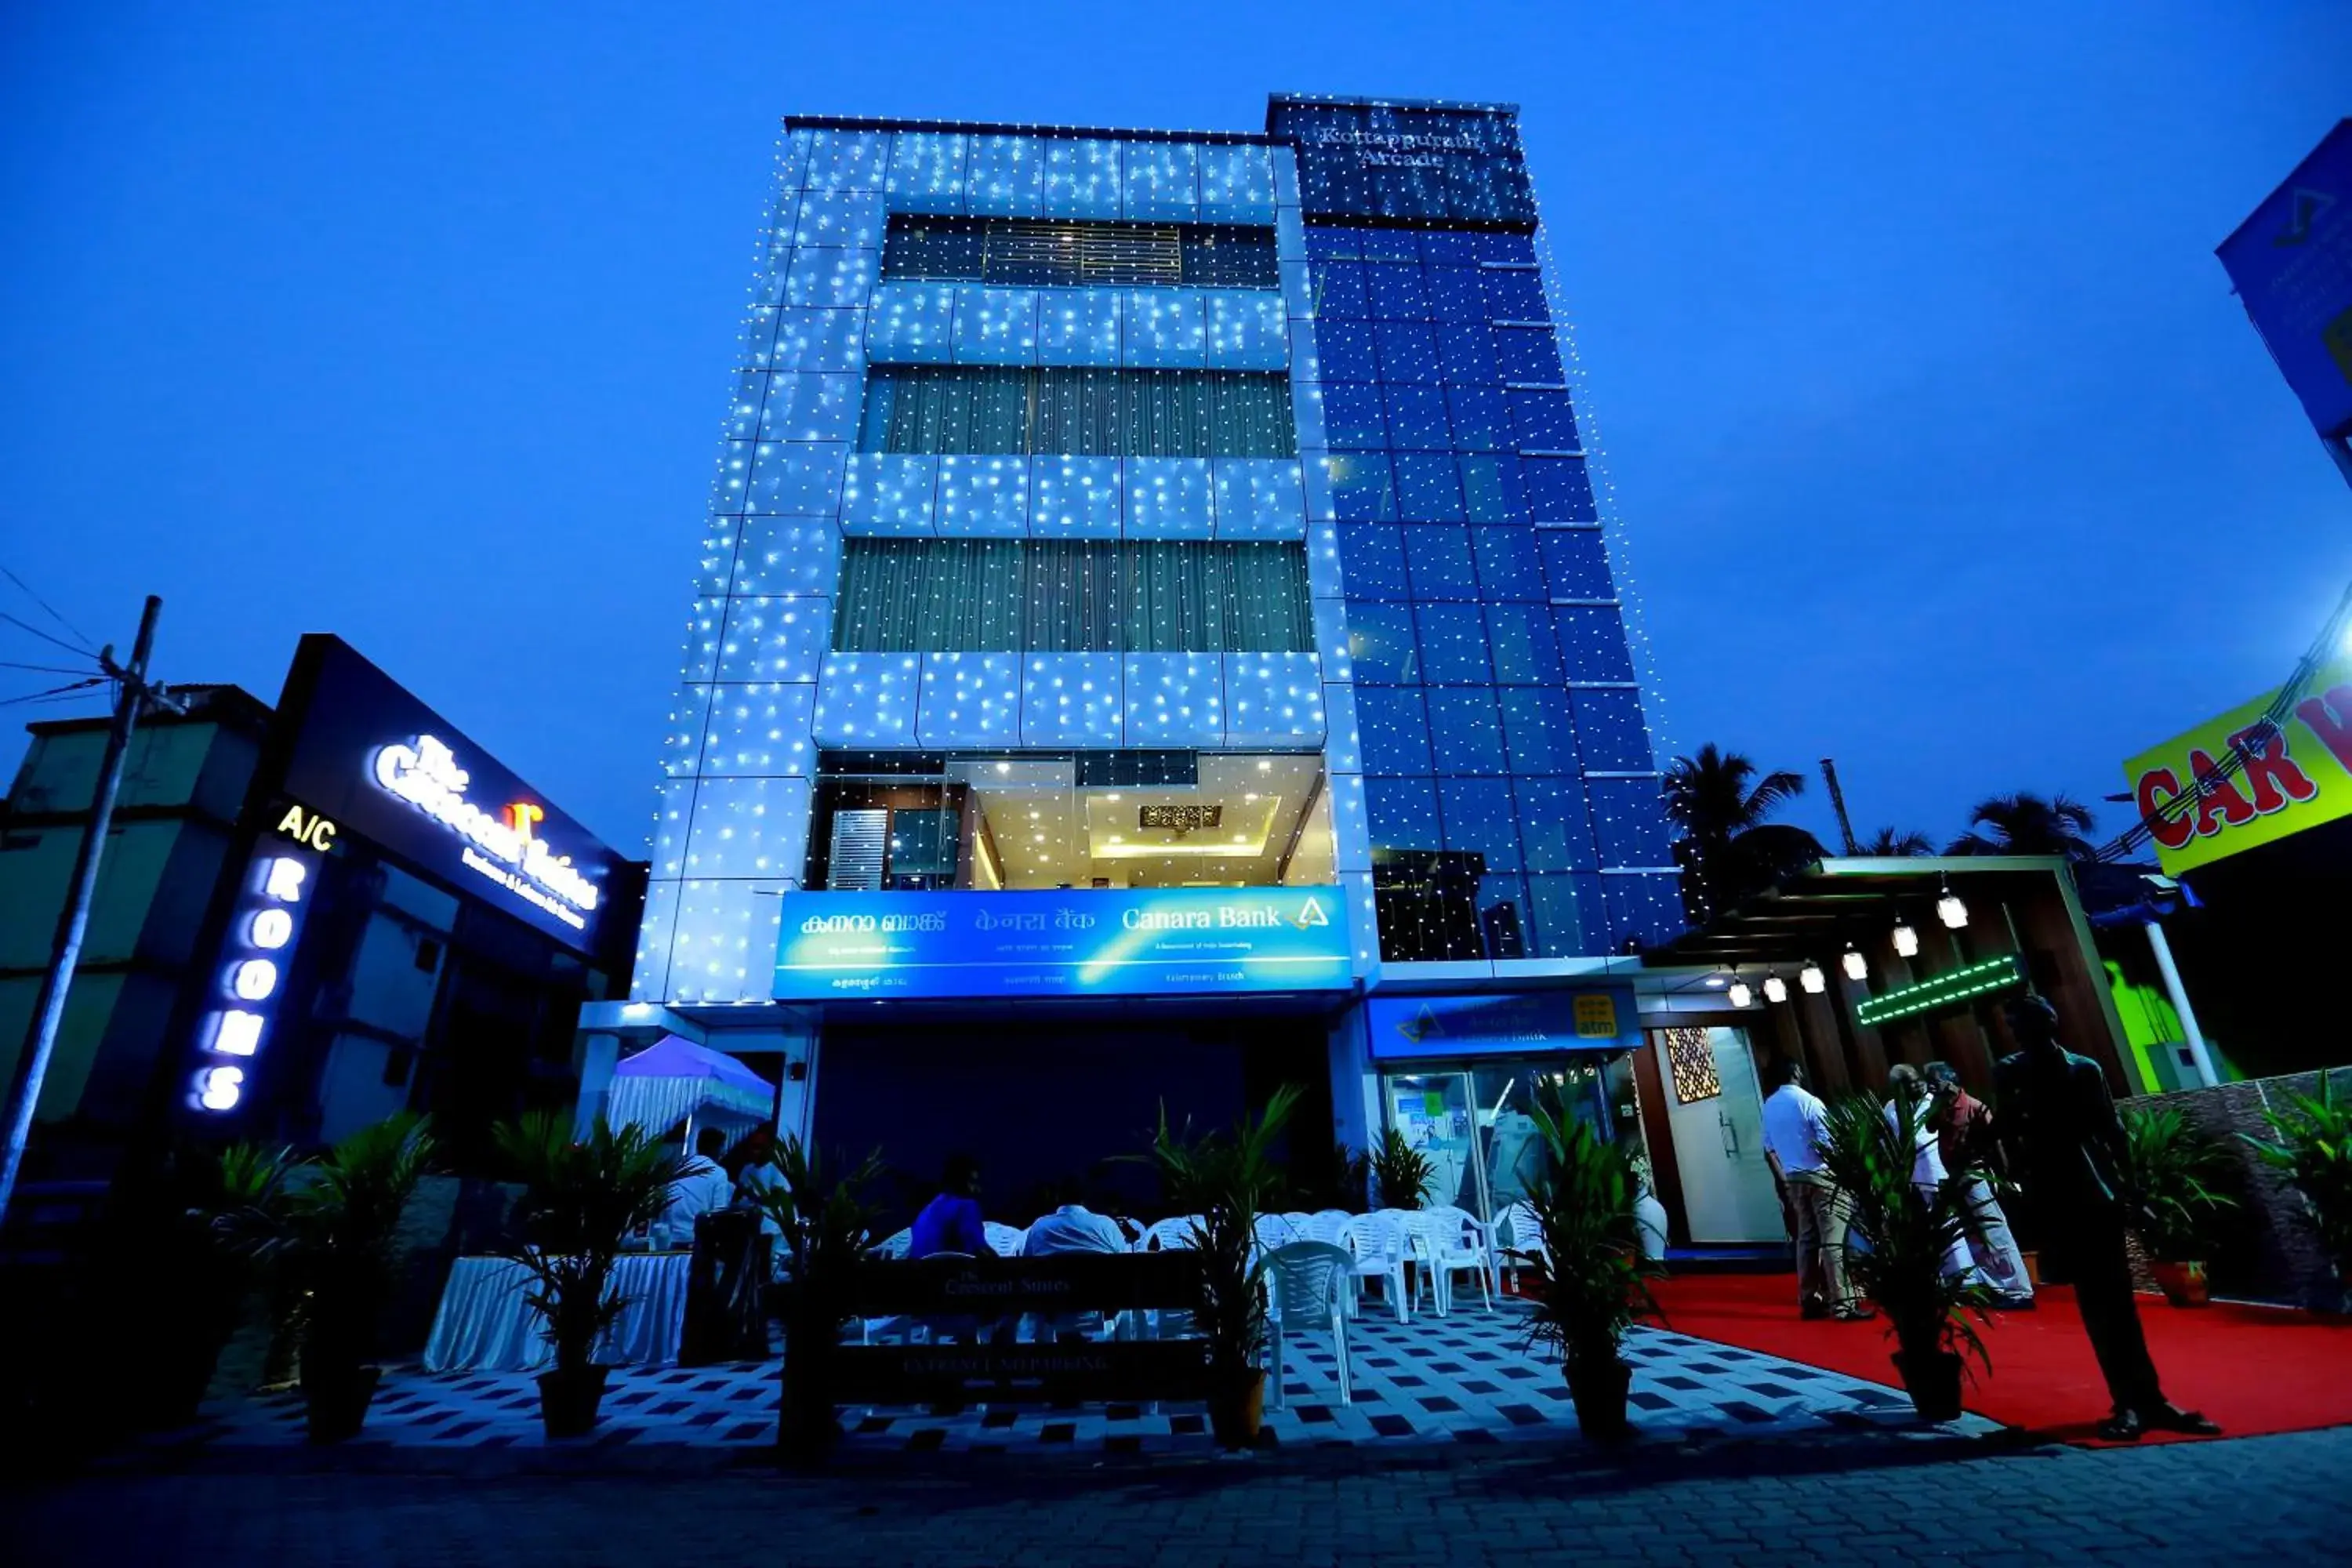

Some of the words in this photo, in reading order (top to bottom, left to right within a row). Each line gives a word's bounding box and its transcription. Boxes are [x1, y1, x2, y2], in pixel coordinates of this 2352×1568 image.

[1319, 126, 1481, 151] Kottappurath
[1360, 148, 1445, 168] Arcade
[2136, 724, 2318, 850] CAR
[278, 805, 336, 851] A/C
[1122, 908, 1211, 930] Canara
[1218, 906, 1282, 928] Bank
[201, 857, 307, 1111] ROOMS
